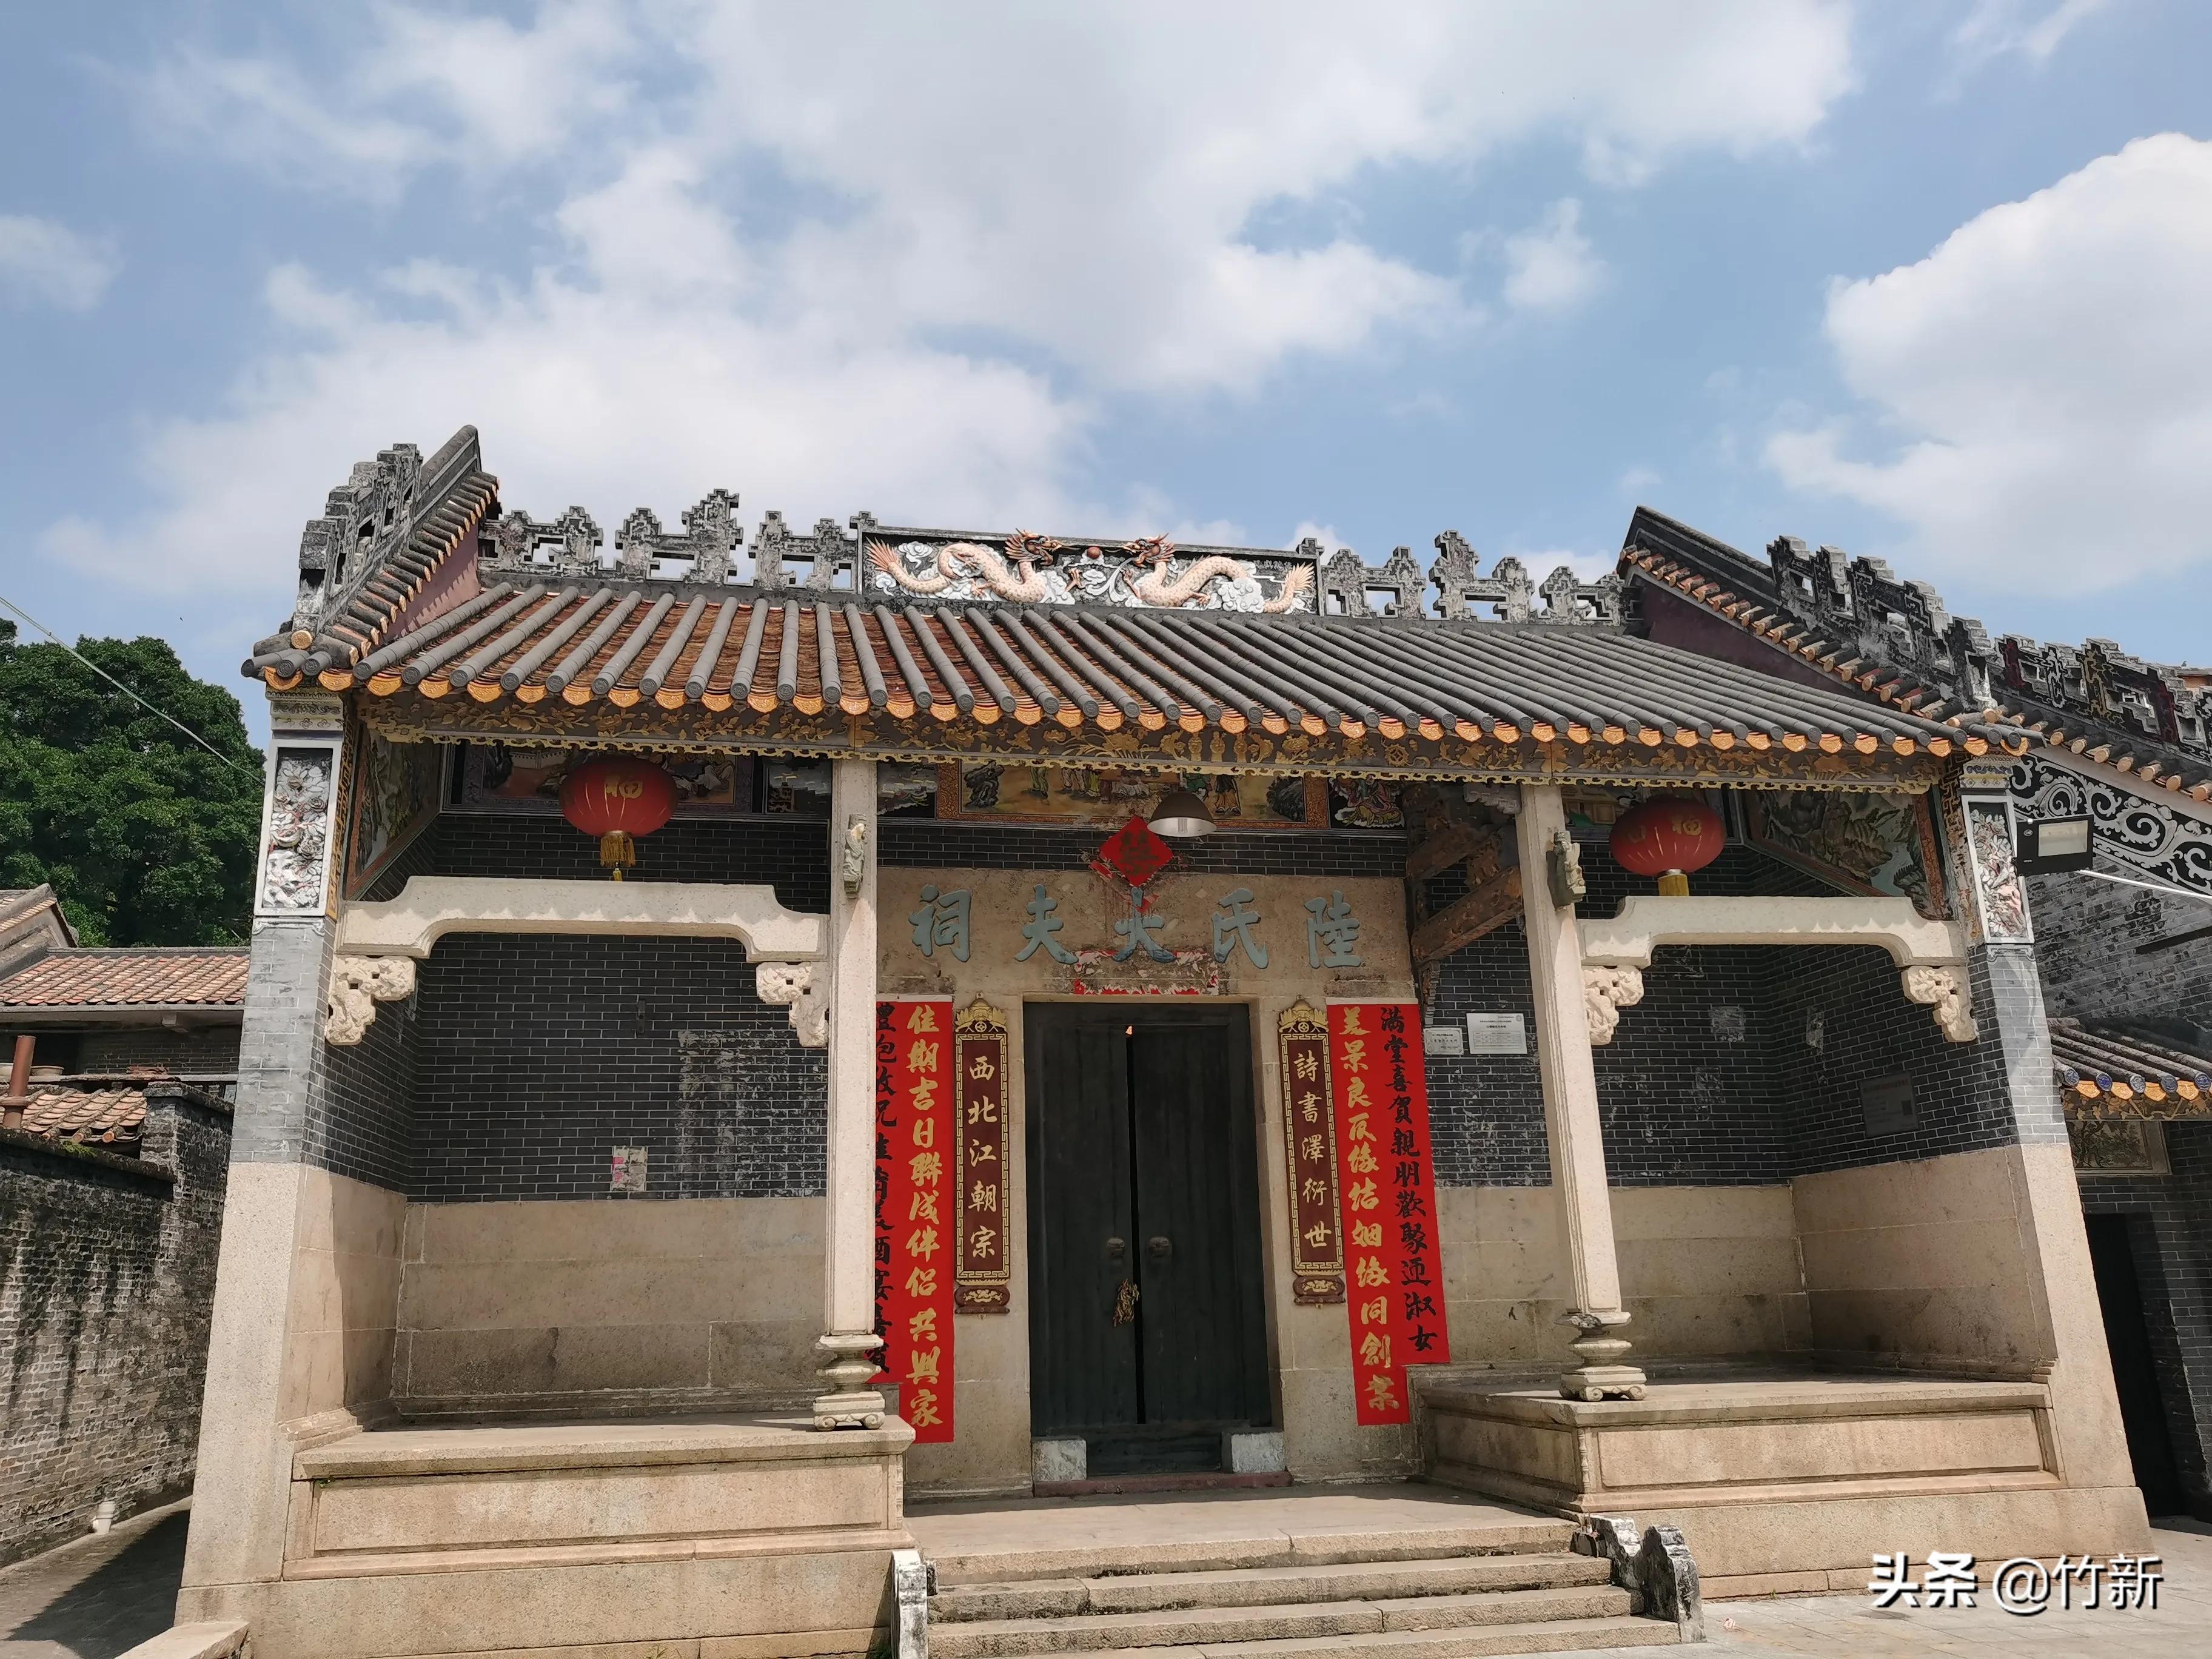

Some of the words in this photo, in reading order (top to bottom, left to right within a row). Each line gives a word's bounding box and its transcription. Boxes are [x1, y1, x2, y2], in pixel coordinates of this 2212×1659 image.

[967, 1055, 997, 1259] 西北江朝宗
